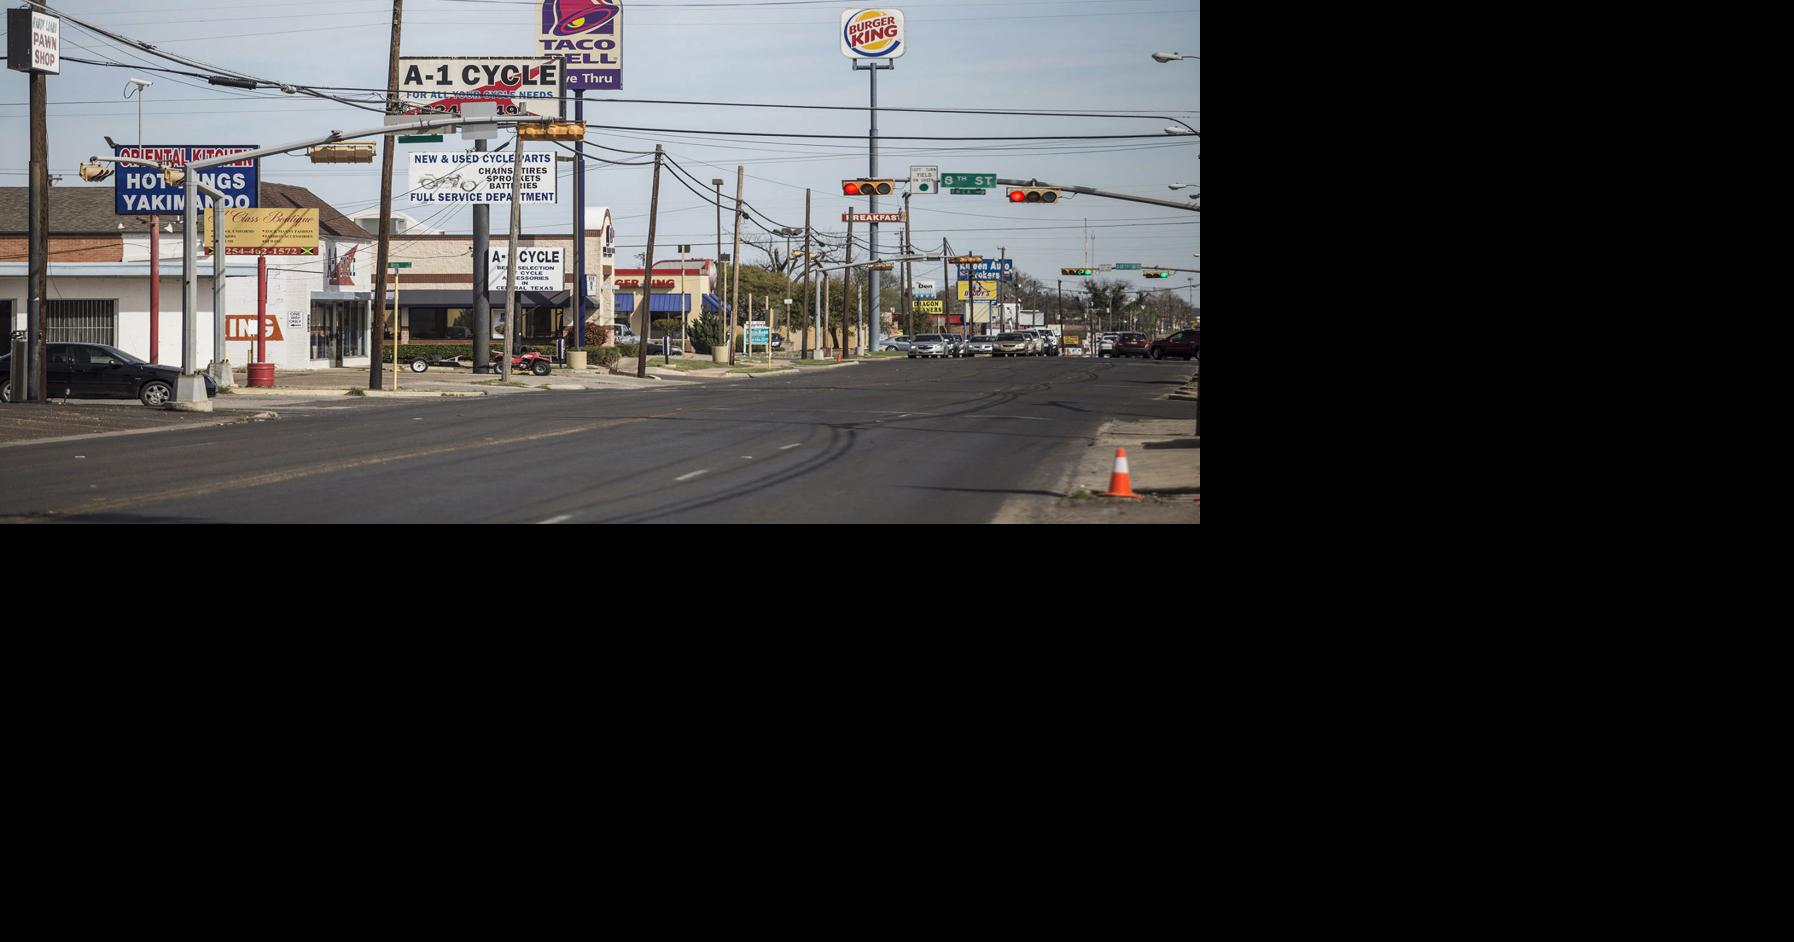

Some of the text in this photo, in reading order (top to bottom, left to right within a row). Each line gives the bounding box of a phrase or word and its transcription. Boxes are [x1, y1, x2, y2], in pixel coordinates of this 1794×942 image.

[849, 16, 895, 35] BURGER
[34, 32, 56, 50] PAWN
[539, 39, 616, 50] TACO
[852, 25, 897, 48] KING
[34, 50, 55, 66] SHOP
[404, 64, 556, 86] A-1 CYCLE
[582, 73, 612, 83] Thru
[120, 148, 188, 167] ORIENTAL
[414, 154, 437, 163] NEW
[441, 155, 448, 163] &
[452, 154, 479, 163] USED
[482, 154, 514, 163] CYCLE
[126, 173, 166, 190] HOT
[975, 176, 992, 186] ST
[410, 193, 554, 202] FULL SERVICE DEPATMENT
[520, 250, 560, 262] CYCLE
